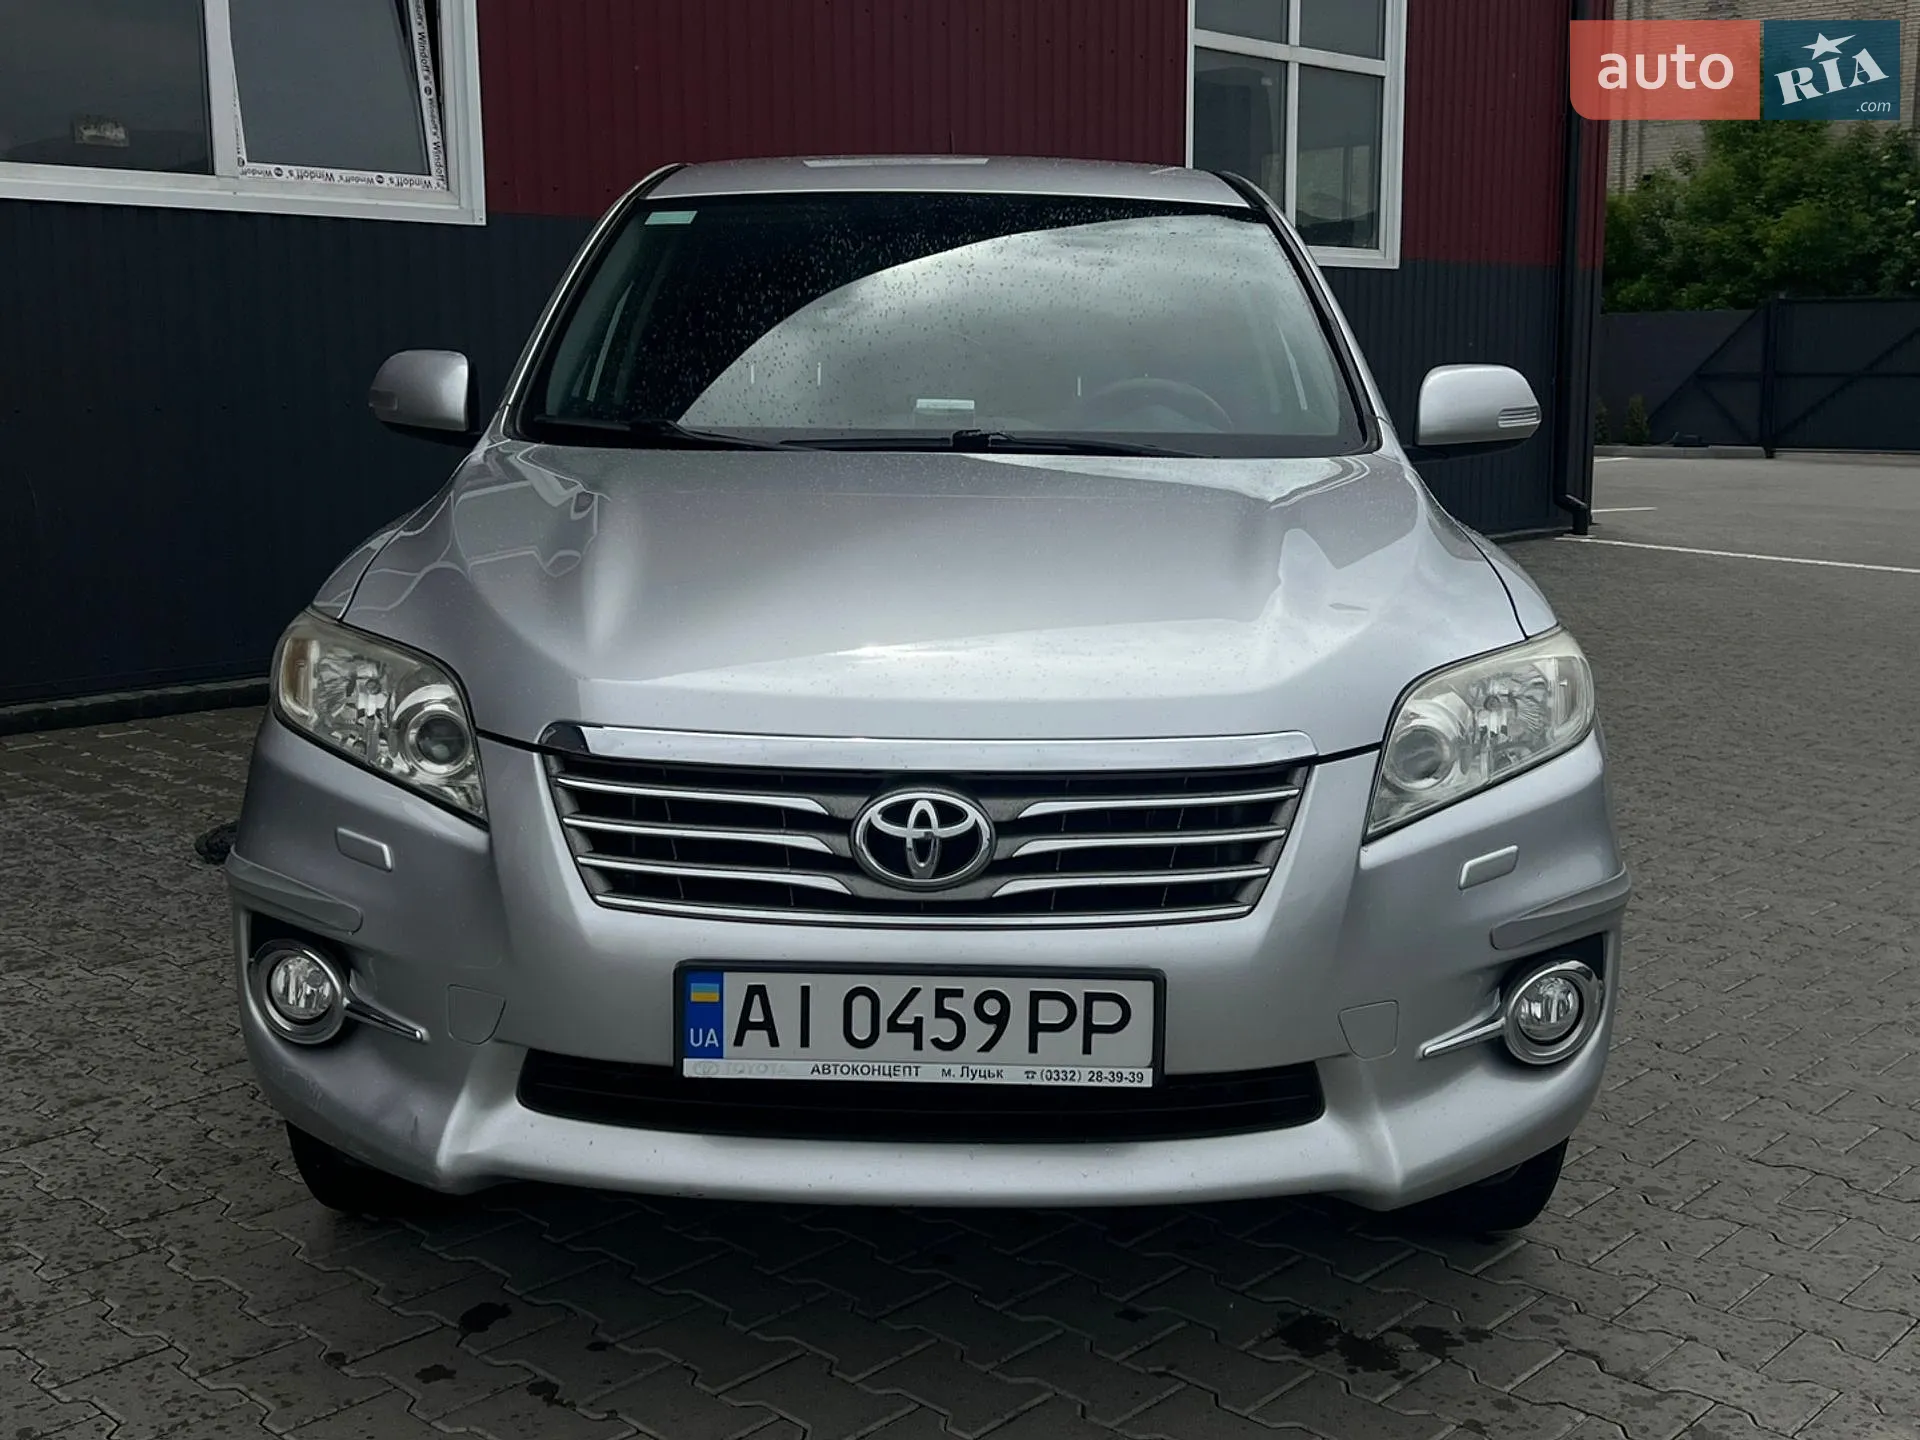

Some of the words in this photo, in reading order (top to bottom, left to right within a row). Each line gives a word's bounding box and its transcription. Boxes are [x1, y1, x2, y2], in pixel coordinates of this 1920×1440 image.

[733, 984, 811, 1048] AI
[843, 986, 1011, 1053] 0459
[1028, 990, 1132, 1055] PP
[690, 1028, 719, 1048] UA
[810, 1063, 920, 1079] АВТОКОНЦЕПТ
[960, 1066, 1004, 1081] Луцьк
[1040, 1069, 1083, 1084] (0332)
[1087, 1070, 1145, 1084] 28-39-39
